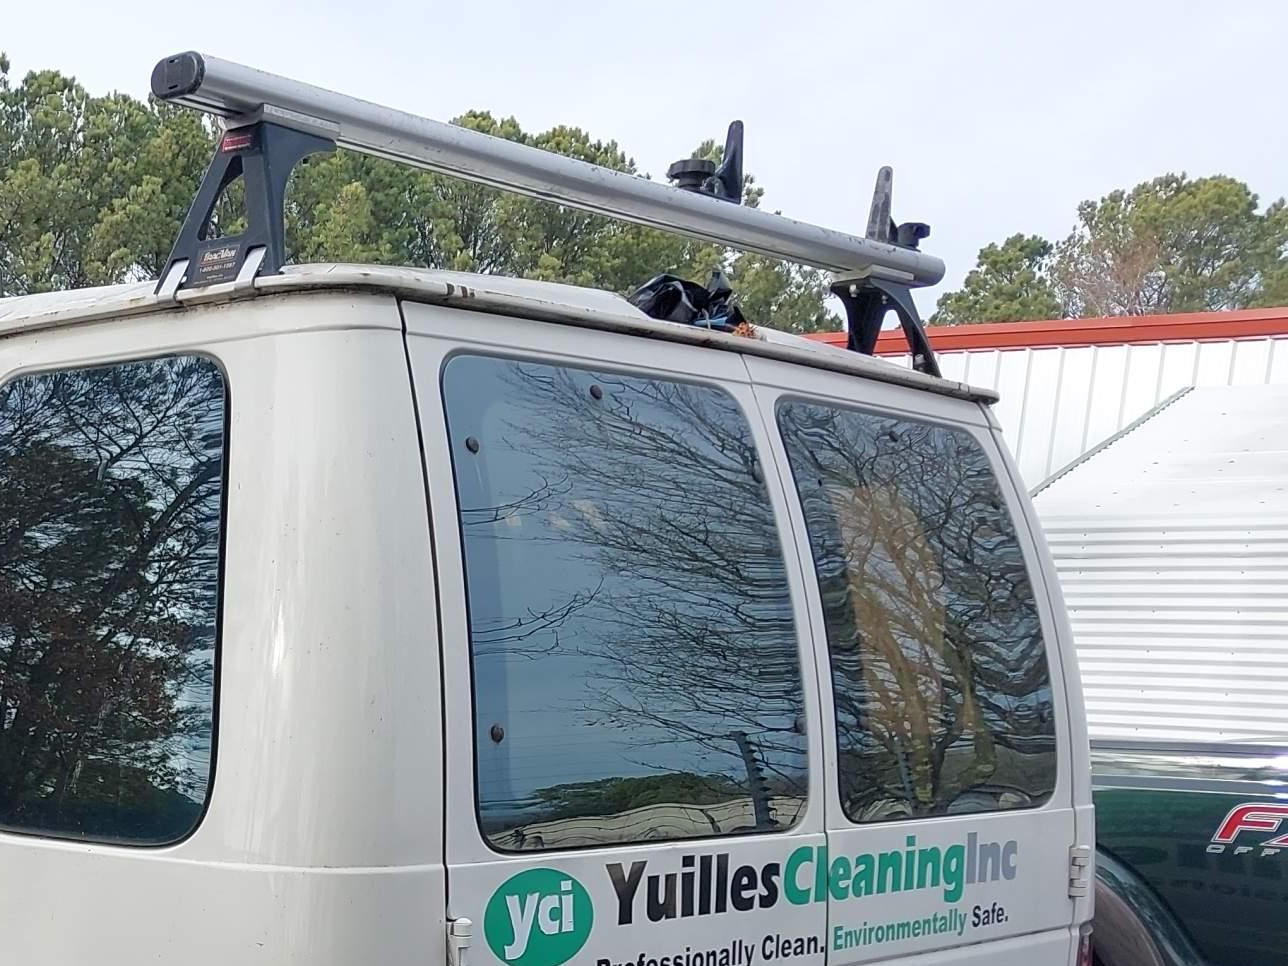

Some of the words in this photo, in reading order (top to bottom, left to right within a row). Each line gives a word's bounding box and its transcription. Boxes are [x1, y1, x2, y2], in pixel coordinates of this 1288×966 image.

[1206, 844, 1281, 857] OFF
[504, 880, 575, 960] yci
[761, 931, 825, 961] Clean.
[833, 908, 968, 952] Environmentally
[971, 902, 1009, 929] Safe.
